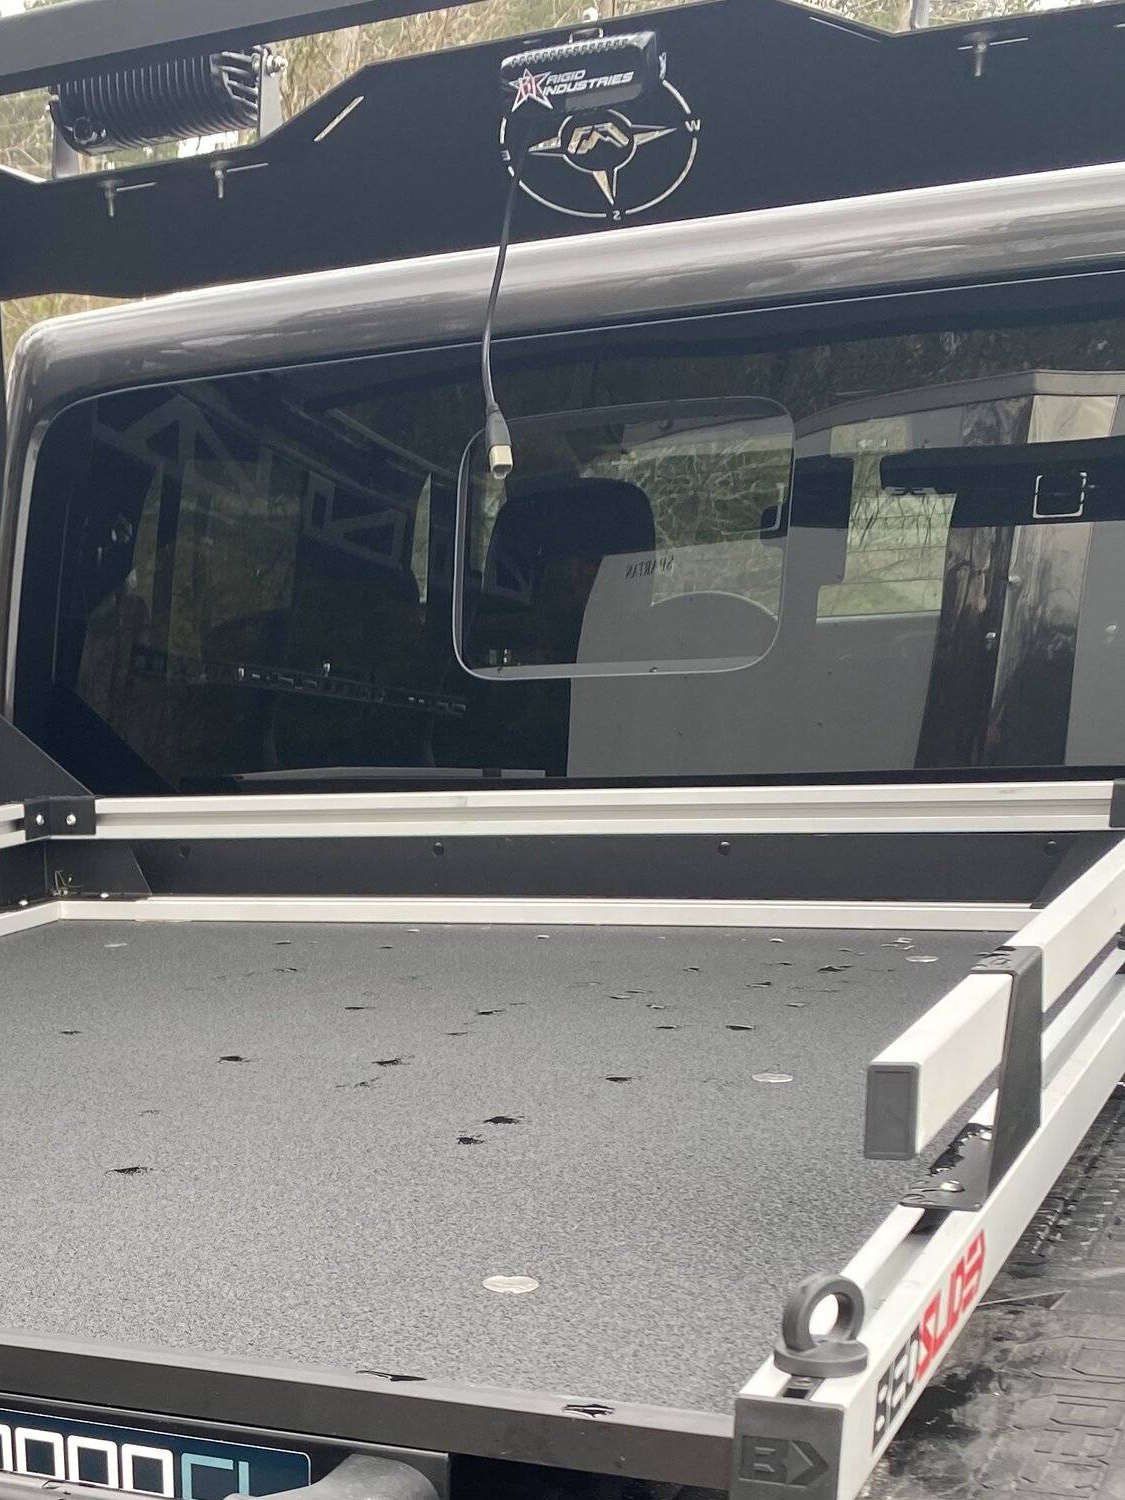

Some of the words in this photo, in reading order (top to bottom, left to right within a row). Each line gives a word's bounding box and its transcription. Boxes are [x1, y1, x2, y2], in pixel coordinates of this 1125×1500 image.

[542, 71, 635, 97] INDUSTRIES
[546, 69, 586, 86] RIGID
[873, 1229, 987, 1455] BEDSLIDE
